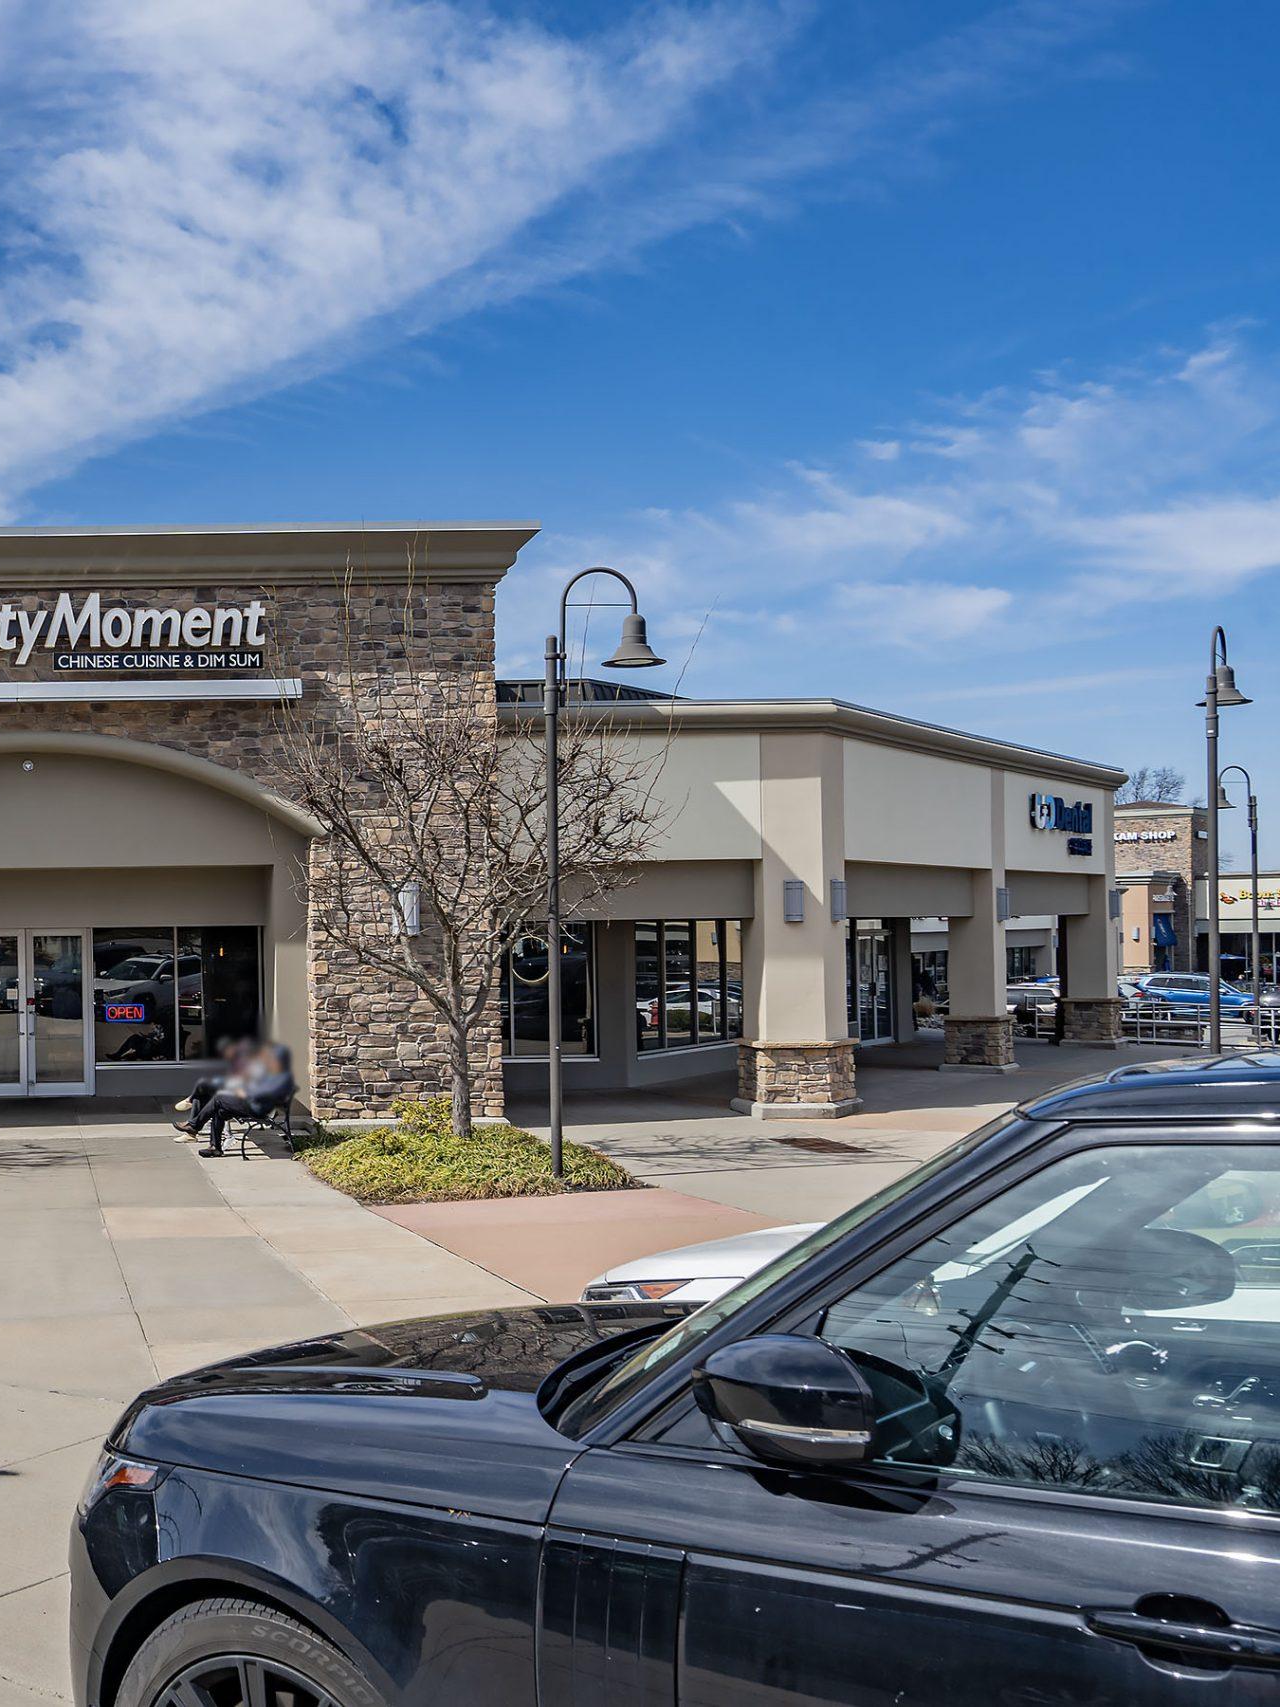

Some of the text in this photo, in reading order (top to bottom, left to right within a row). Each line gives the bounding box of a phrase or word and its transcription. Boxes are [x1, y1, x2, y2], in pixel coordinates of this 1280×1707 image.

[58, 654, 260, 669] CHINESE CUISINE & DIM SUM
[1140, 831, 1176, 840] SHOP
[108, 1006, 142, 1019] OPEN
